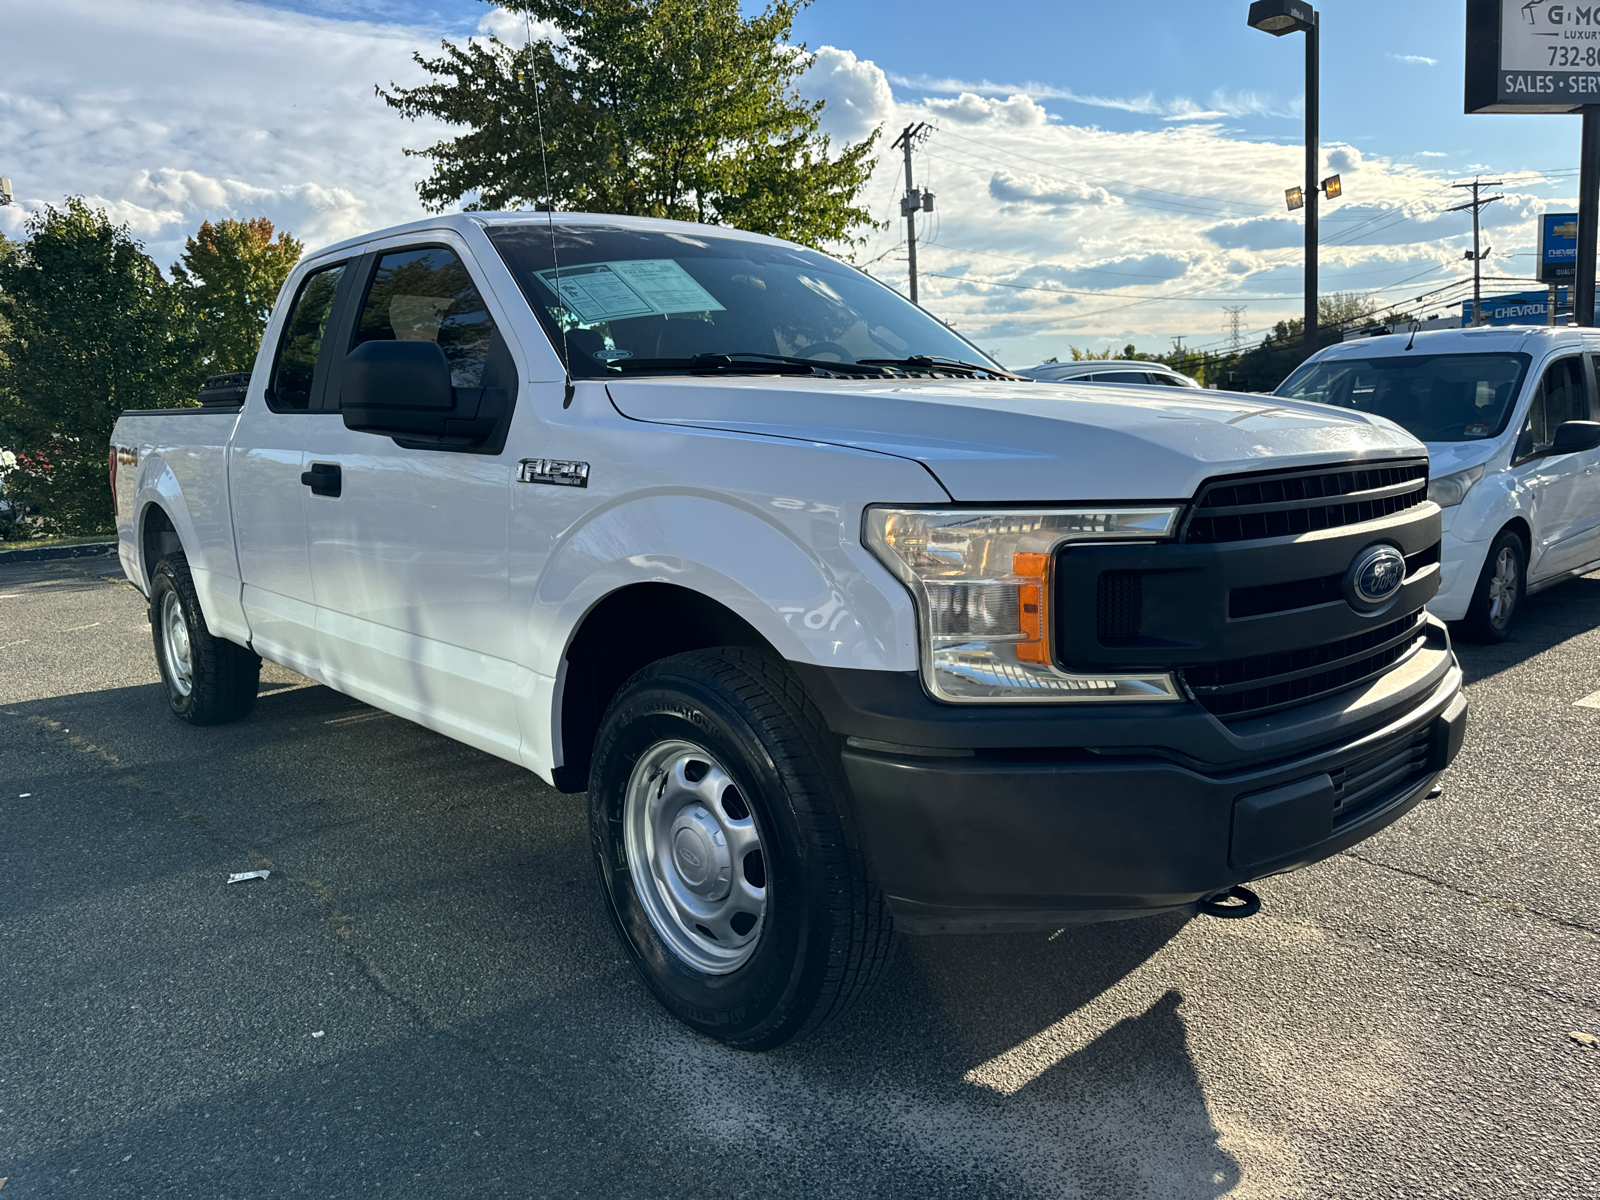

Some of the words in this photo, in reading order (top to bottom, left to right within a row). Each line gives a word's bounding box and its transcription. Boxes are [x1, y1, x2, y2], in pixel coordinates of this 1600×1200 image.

[1505, 75, 1555, 93] SALES
[1370, 562, 1400, 593] Ford
[644, 703, 710, 730] DESTINATION
